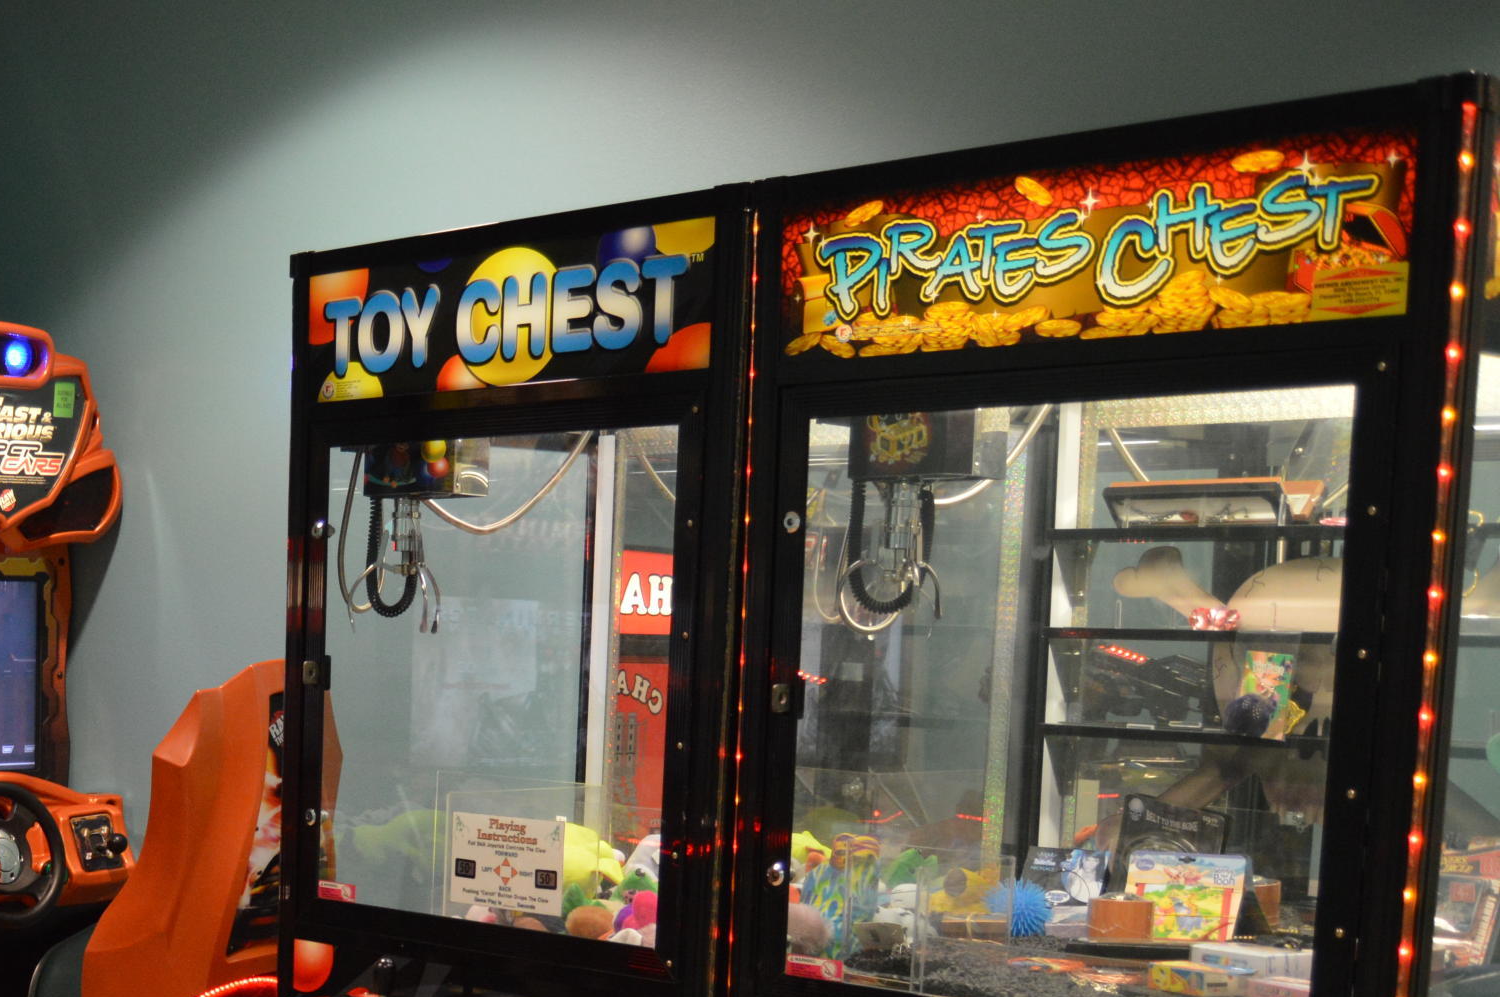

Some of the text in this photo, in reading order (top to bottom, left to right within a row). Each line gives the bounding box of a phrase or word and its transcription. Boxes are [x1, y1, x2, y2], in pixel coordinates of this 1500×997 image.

[818, 173, 1381, 319] PIRATES CHEST
[324, 283, 441, 376] TOY
[455, 254, 690, 364] CHEST
[42, 410, 54, 424] &
[0, 457, 63, 476] CARS
[488, 818, 527, 835] Playing
[477, 829, 538, 845] Instructions
